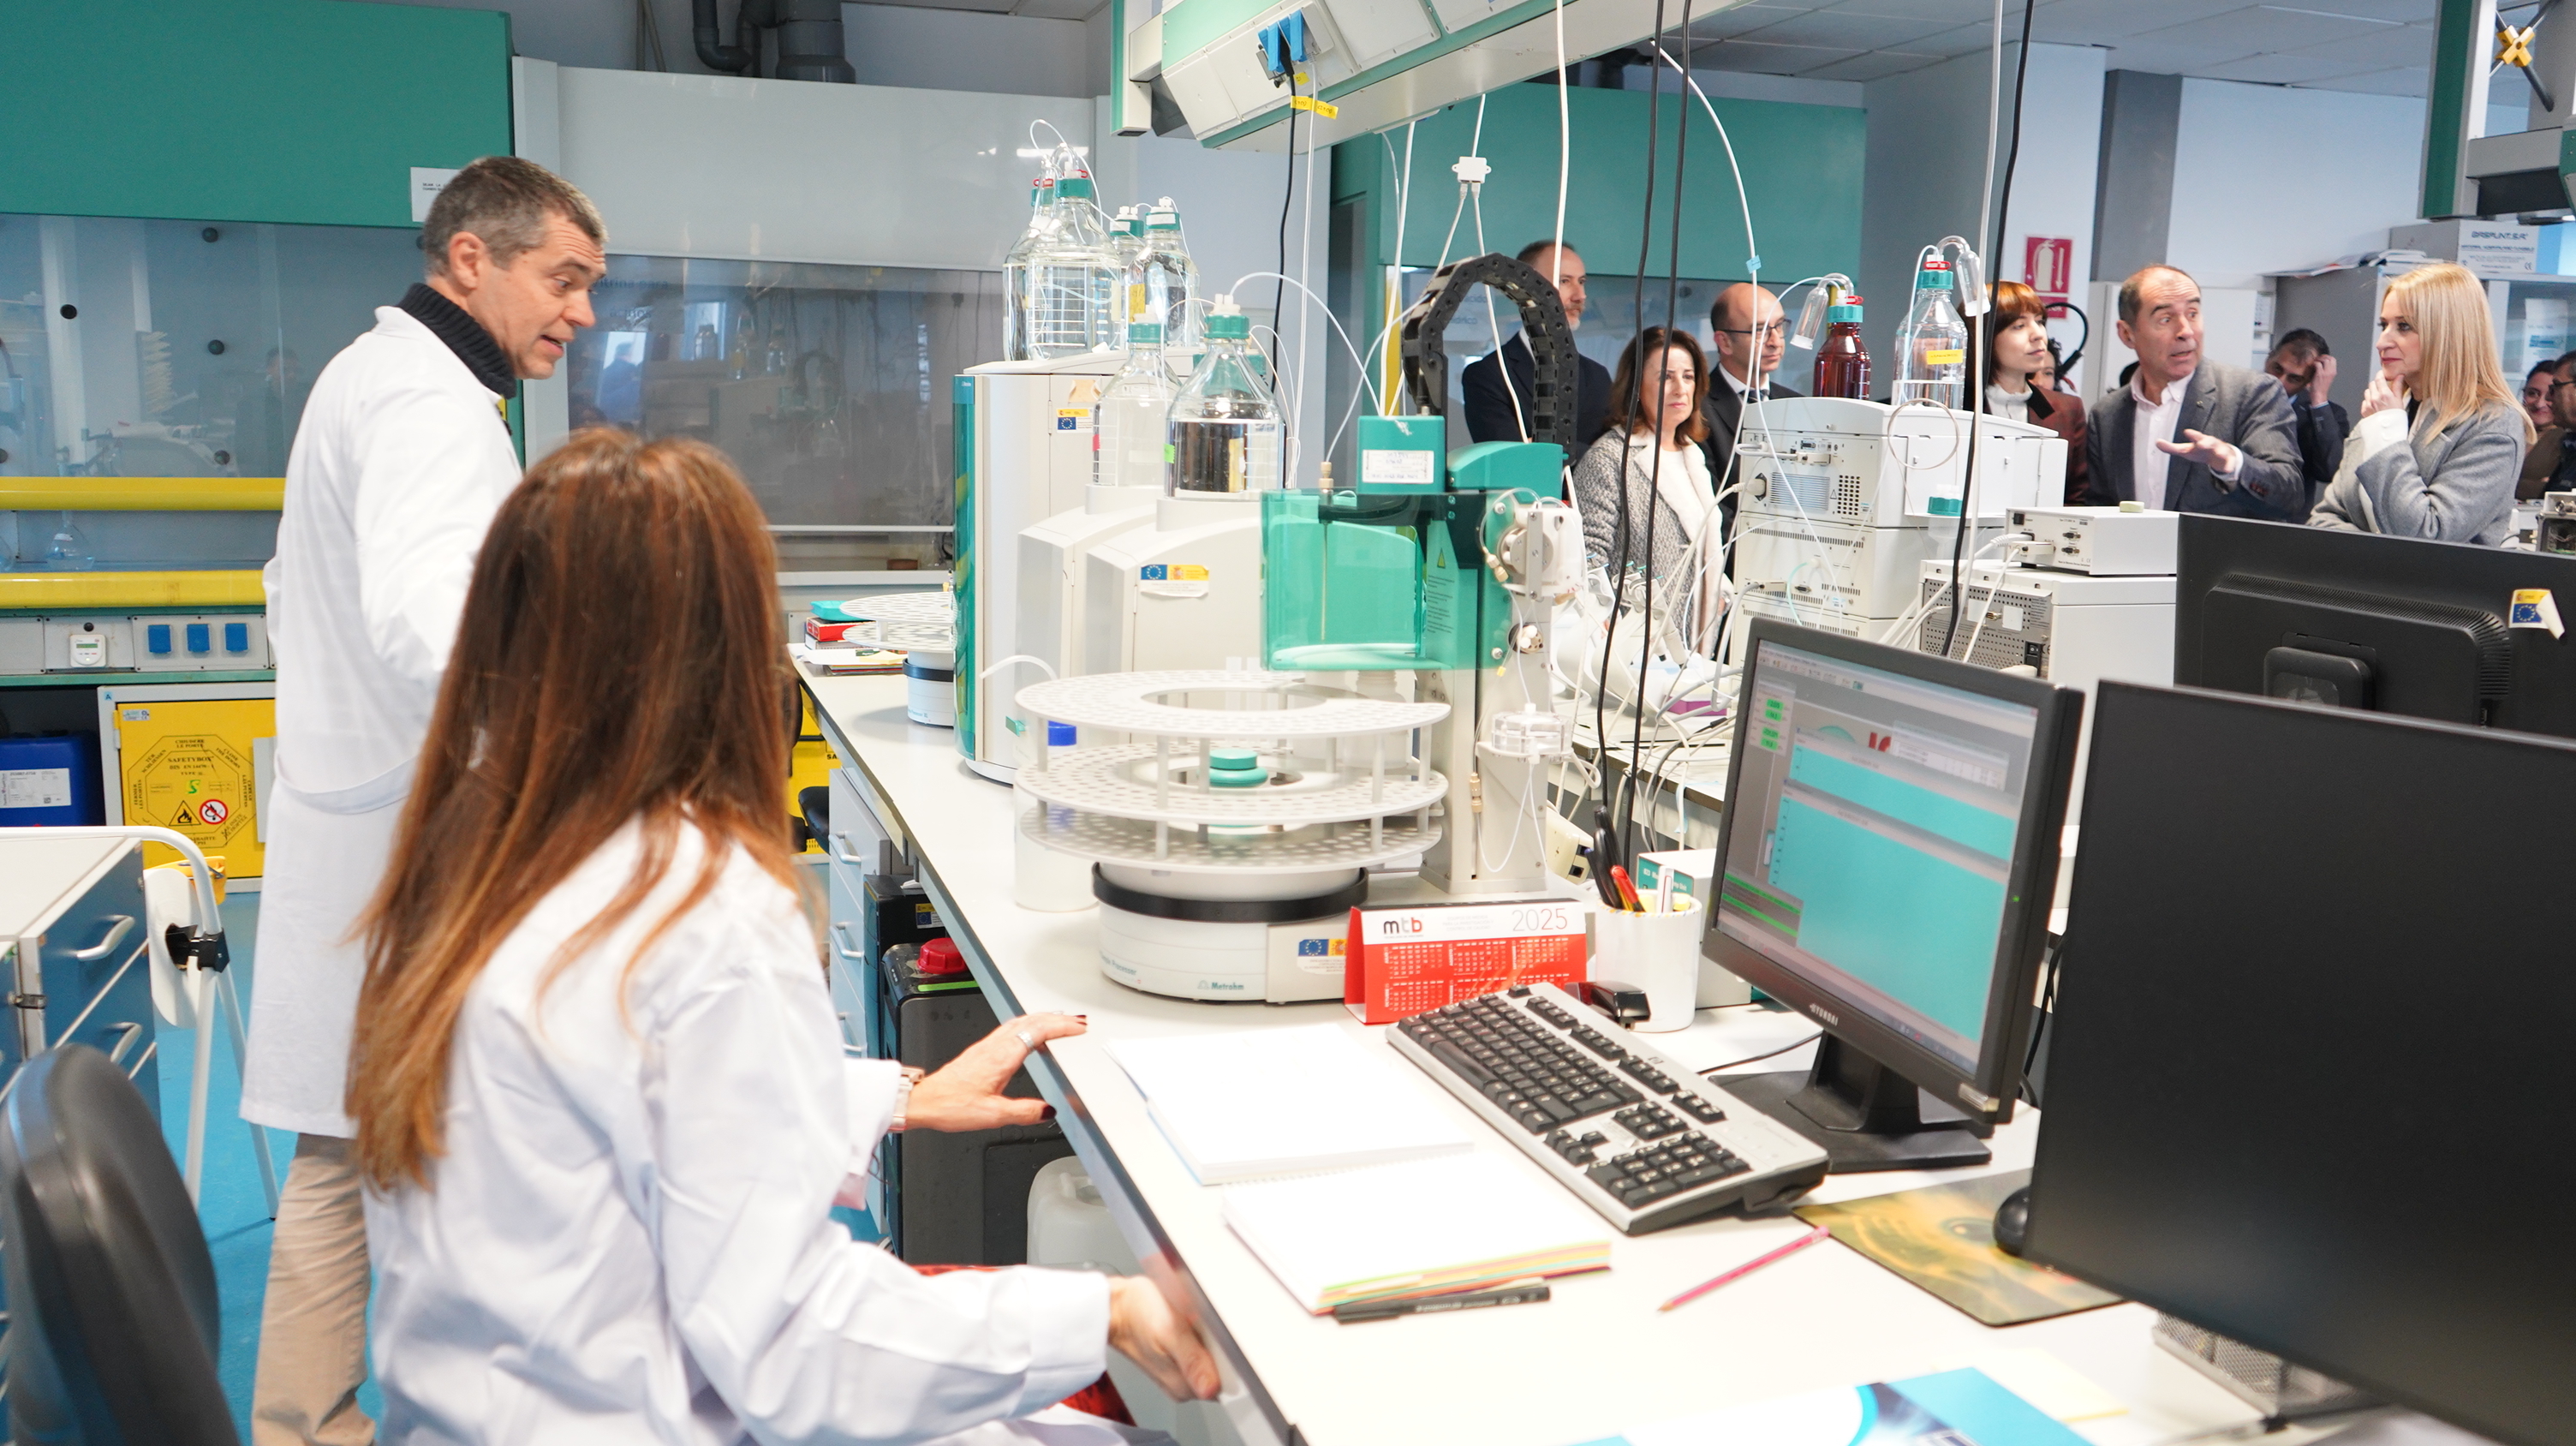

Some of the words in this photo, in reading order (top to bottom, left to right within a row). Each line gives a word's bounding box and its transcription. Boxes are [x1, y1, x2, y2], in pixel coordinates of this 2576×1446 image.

[1383, 917, 1422, 935] mtb
[1512, 908, 1568, 931] 2025
[1211, 982, 1244, 990] Metrohm
[1809, 1003, 1839, 1026] HYUNDAI
